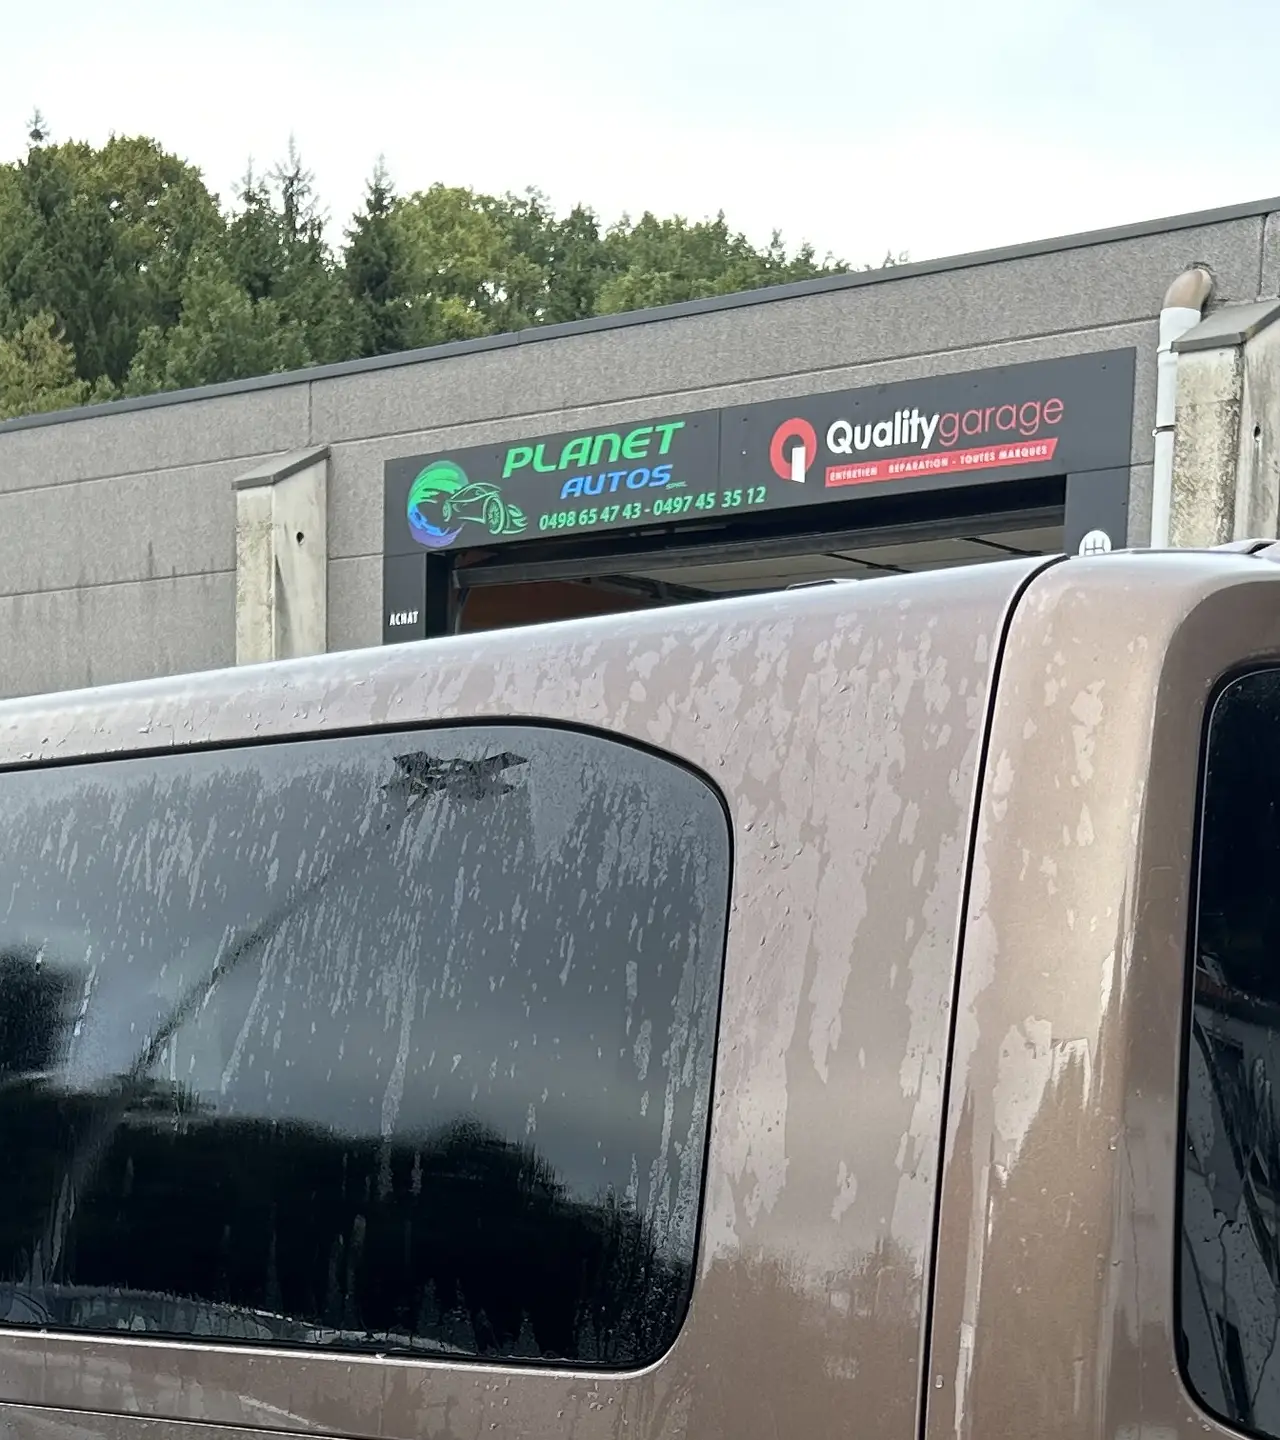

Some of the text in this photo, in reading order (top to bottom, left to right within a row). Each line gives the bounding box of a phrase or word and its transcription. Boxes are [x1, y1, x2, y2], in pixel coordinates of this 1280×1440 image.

[501, 421, 686, 479] PLANET
[829, 467, 878, 482] ENTRETIEN
[959, 452, 996, 465] TOUTES
[998, 445, 1048, 460] MARQUES
[560, 464, 674, 499] AUTOS
[539, 511, 576, 531] 0498
[578, 507, 598, 526] 65
[599, 505, 620, 523] 47
[622, 502, 642, 520] 43
[653, 495, 694, 516] 0497
[695, 491, 716, 510] 45
[721, 489, 743, 508] 35
[747, 486, 767, 505] 12
[389, 611, 419, 627] ACHAT
